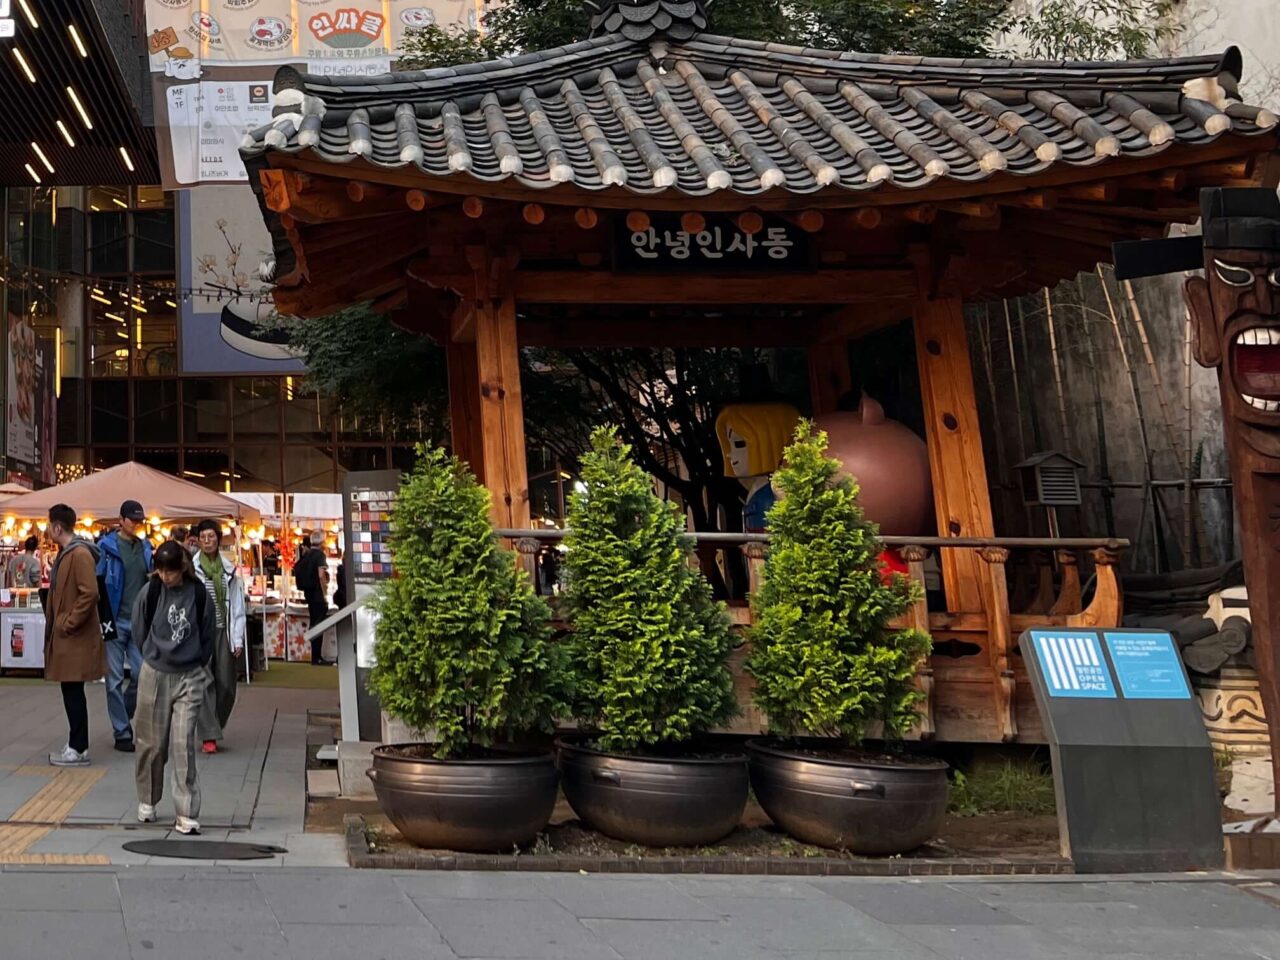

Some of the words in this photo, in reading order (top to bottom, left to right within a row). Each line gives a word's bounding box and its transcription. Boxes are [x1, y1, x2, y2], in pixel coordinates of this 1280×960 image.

[631, 226, 794, 259] 안녕인사동
[1079, 674, 1105, 683] OPEN
[1081, 682, 1108, 691] SPACE
